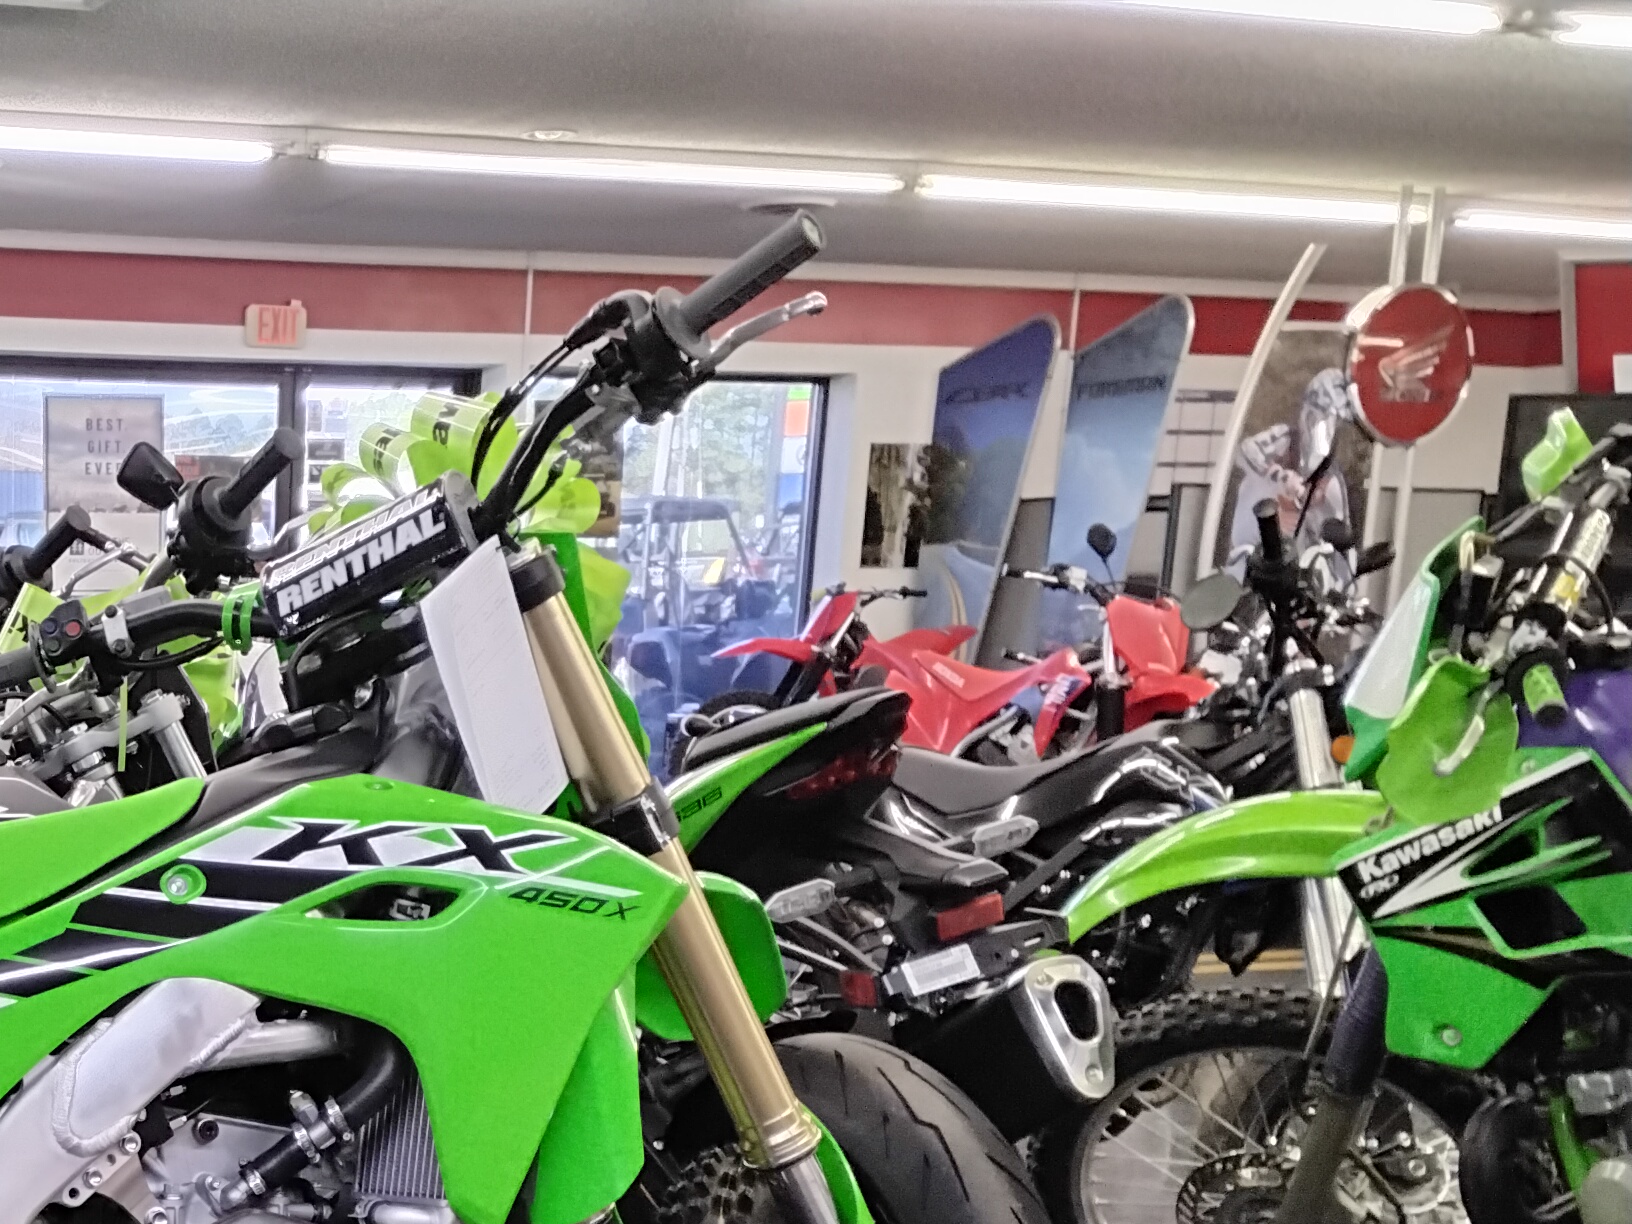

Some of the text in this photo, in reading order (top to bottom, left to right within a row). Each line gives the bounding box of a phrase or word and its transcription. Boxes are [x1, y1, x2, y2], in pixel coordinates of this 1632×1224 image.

[257, 306, 297, 344] EXIT
[276, 508, 447, 618] RENTHAL
[252, 818, 579, 876] KX
[1356, 804, 1504, 885] Kawasaki
